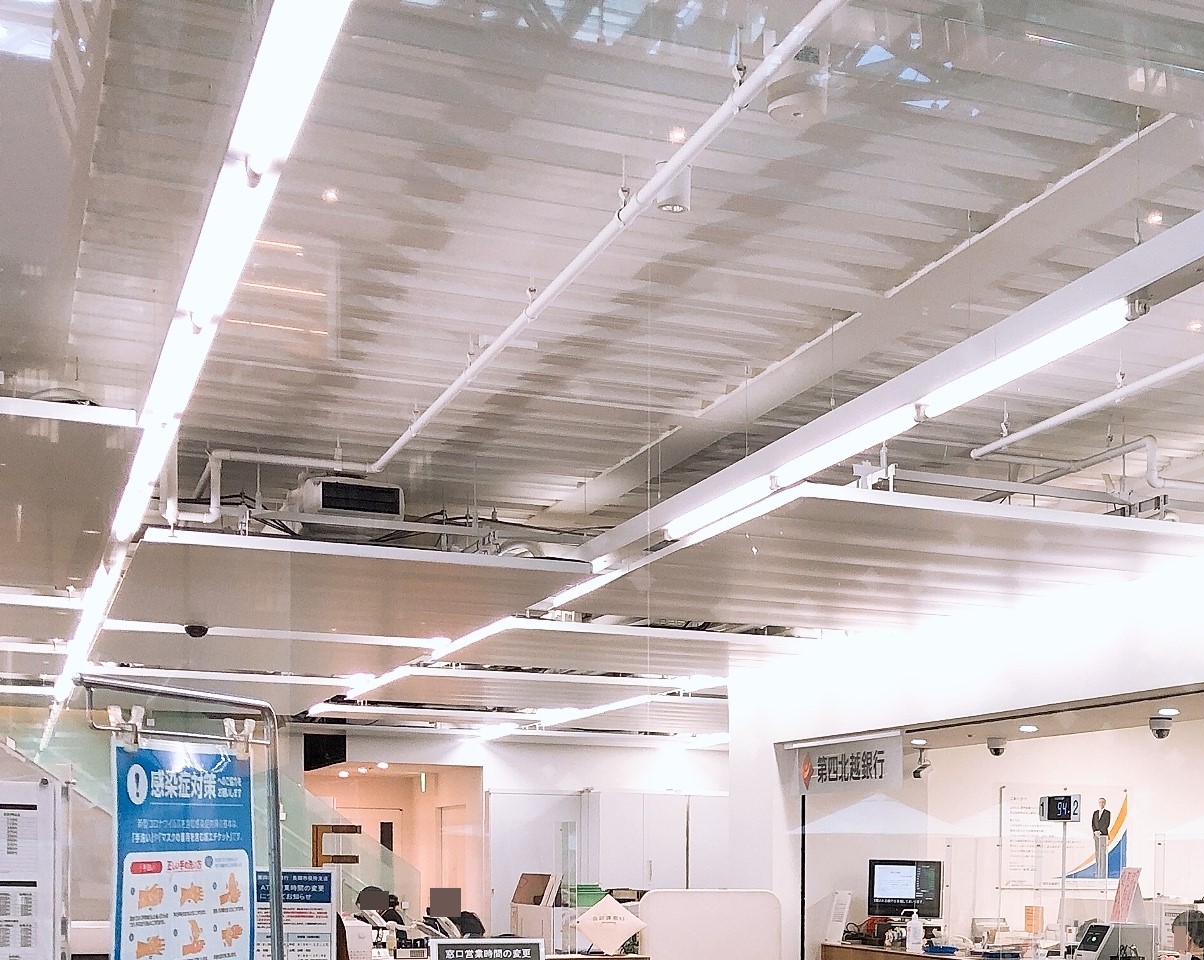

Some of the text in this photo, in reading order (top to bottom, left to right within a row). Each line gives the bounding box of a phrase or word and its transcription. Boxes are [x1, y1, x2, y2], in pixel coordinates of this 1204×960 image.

[817, 750, 885, 783] 第四北越銀行
[151, 770, 217, 799] 感染症対策
[1040, 800, 1079, 817] 1 94 2
[445, 949, 532, 959] 窓口営業時間の変更
